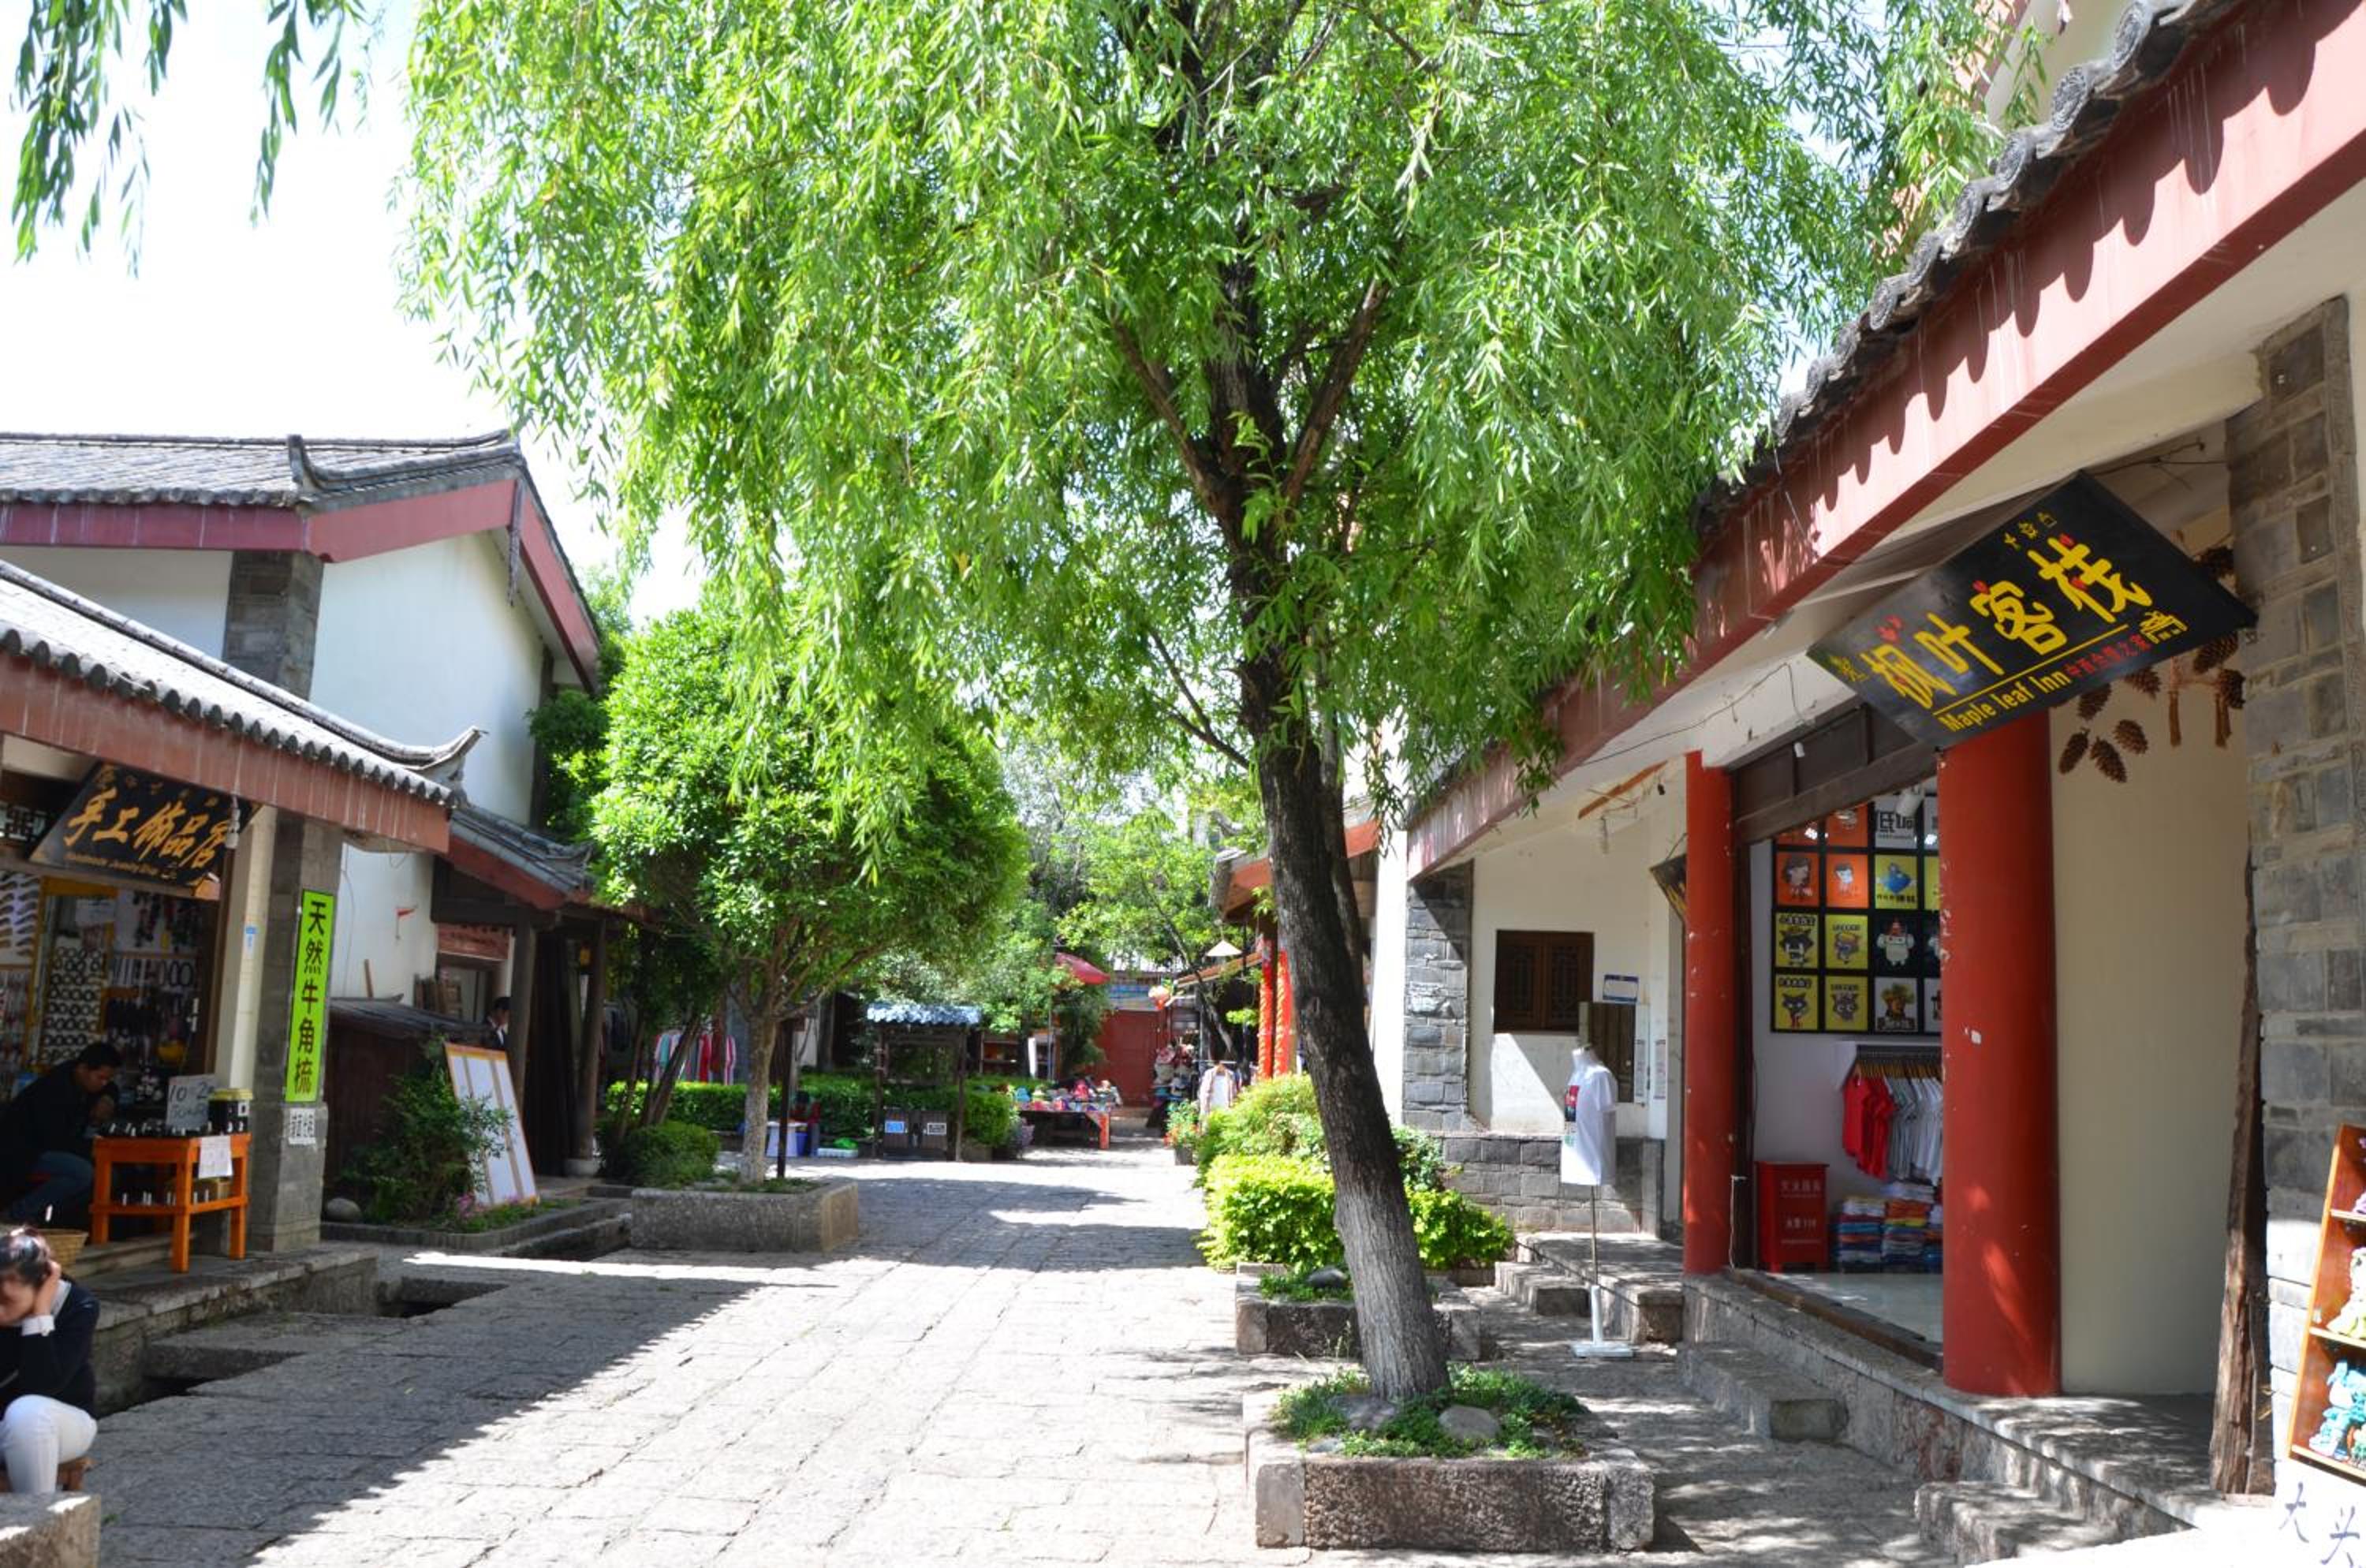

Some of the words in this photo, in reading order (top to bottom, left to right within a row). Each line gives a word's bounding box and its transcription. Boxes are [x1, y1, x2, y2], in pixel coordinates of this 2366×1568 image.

[1860, 535, 2153, 709] 枫叶客栈
[1938, 700, 1997, 732] Maple
[1995, 683, 2036, 710] leaf
[2031, 669, 2072, 695] Inn
[294, 900, 327, 1095] 天然牛角梳
